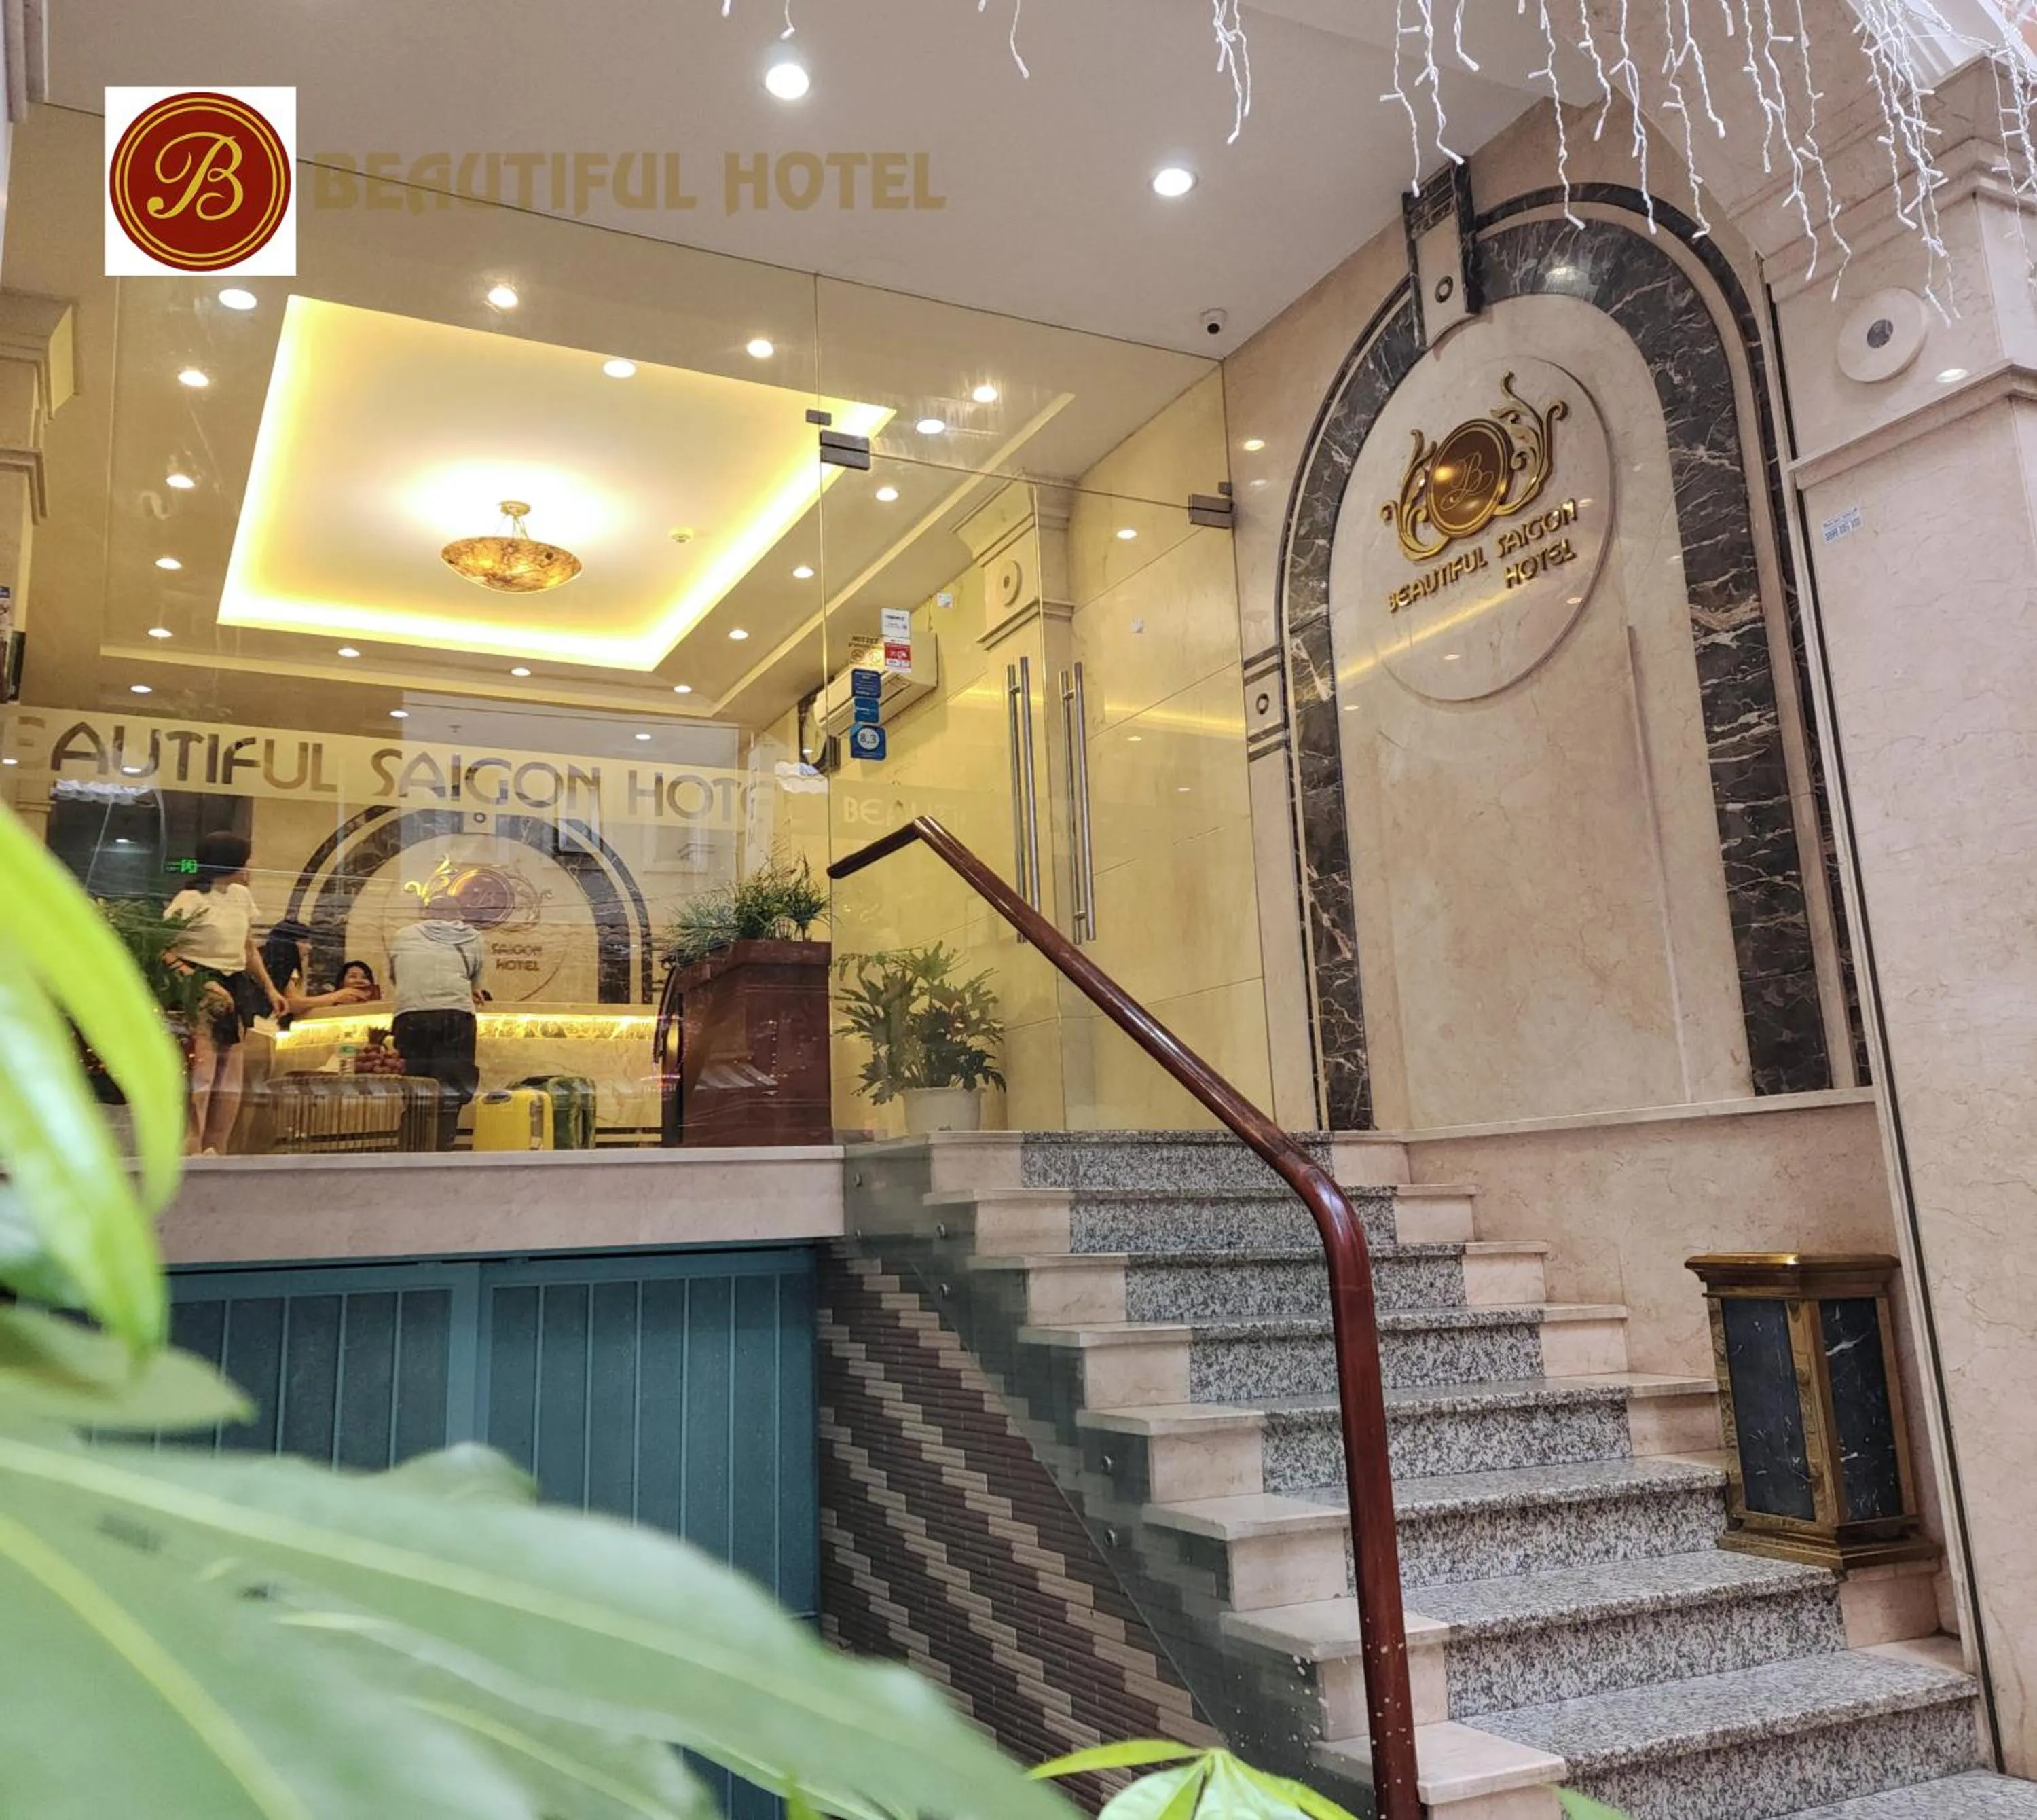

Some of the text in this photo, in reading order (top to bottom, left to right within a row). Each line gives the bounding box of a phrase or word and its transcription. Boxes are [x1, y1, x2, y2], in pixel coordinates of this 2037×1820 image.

[1388, 499, 1577, 613] BEAUTIFUL SAIGON
[1505, 539, 1576, 588] HOTEL
[371, 748, 601, 808] SAIGON
[496, 958, 540, 971] HOTEL
